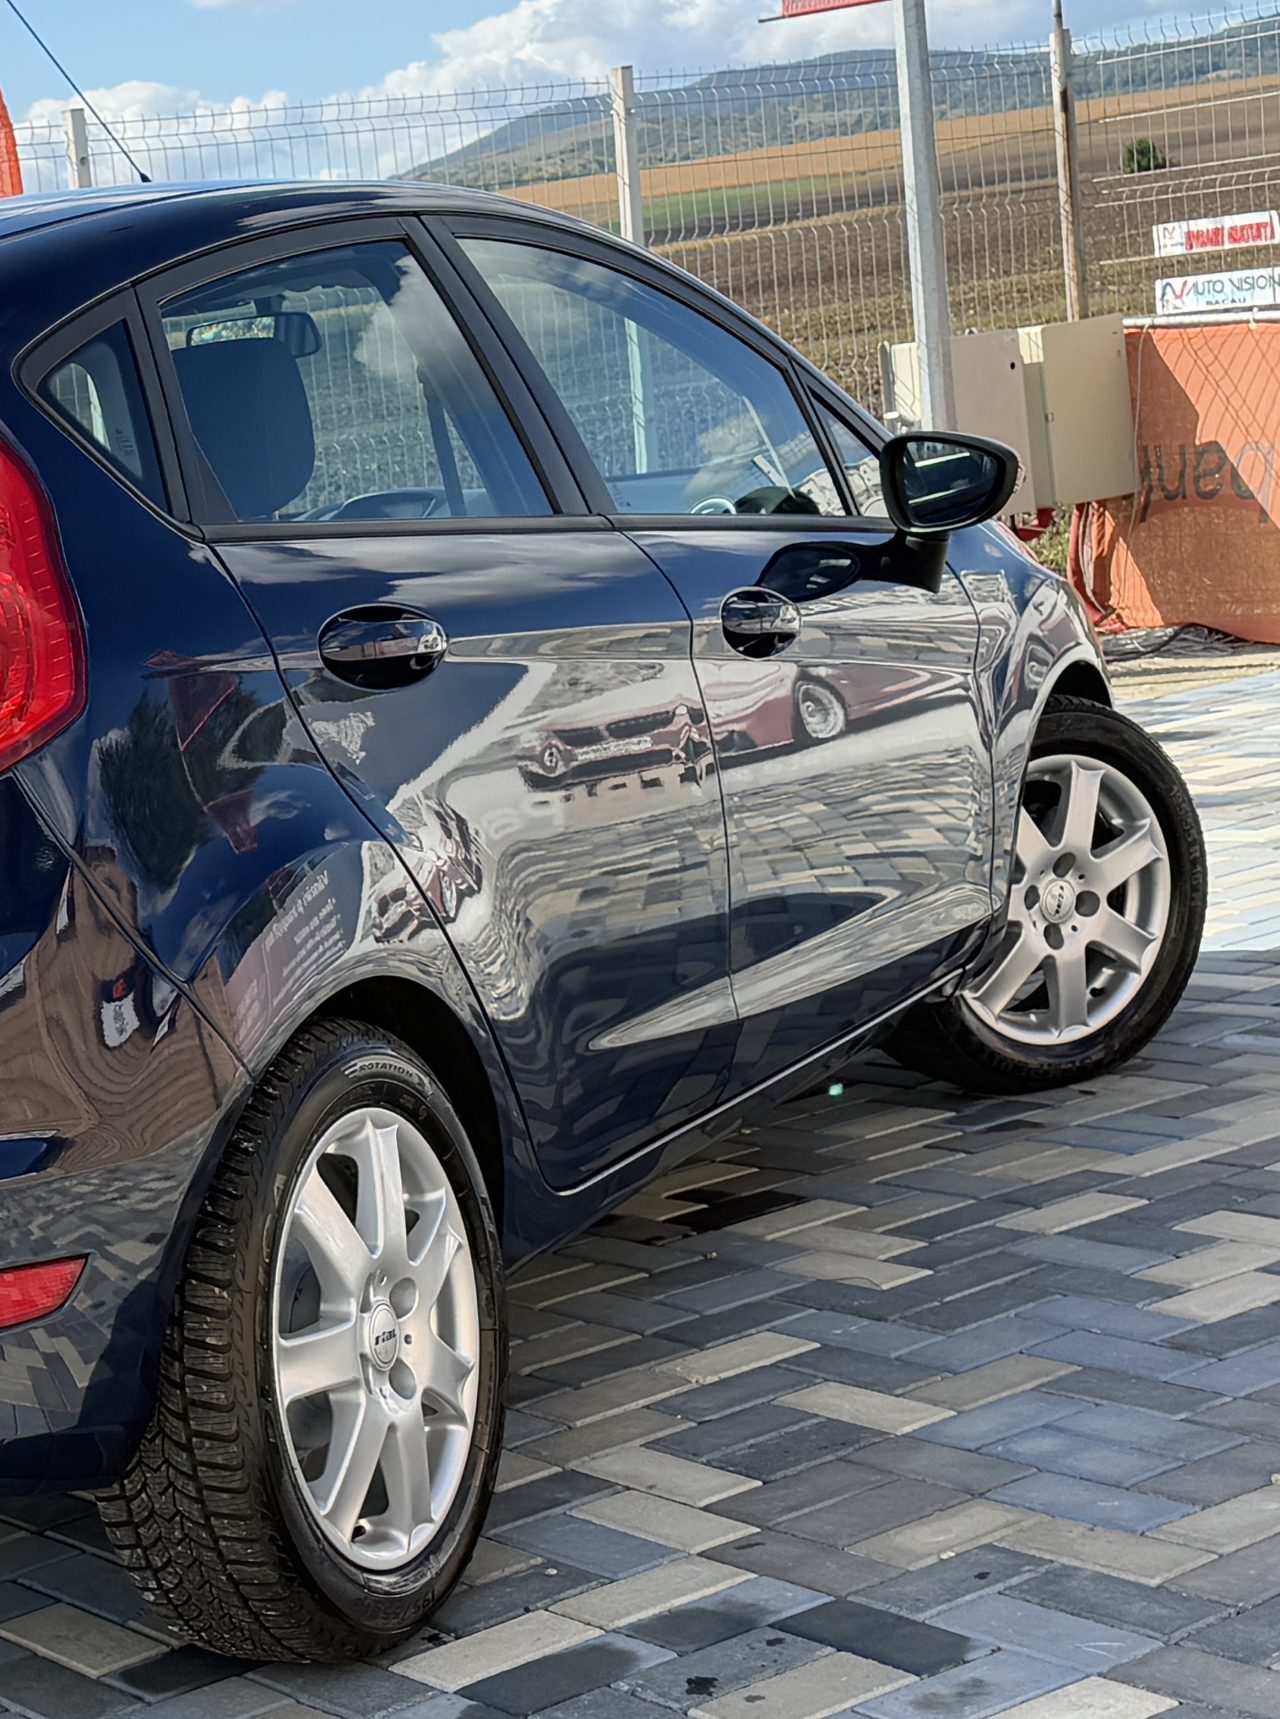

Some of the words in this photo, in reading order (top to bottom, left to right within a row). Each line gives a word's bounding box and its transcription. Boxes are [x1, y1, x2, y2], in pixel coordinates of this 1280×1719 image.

[1185, 279, 1225, 297] AUTO
[1228, 274, 1280, 292] VISION
[358, 1062, 414, 1078] ROTATION
